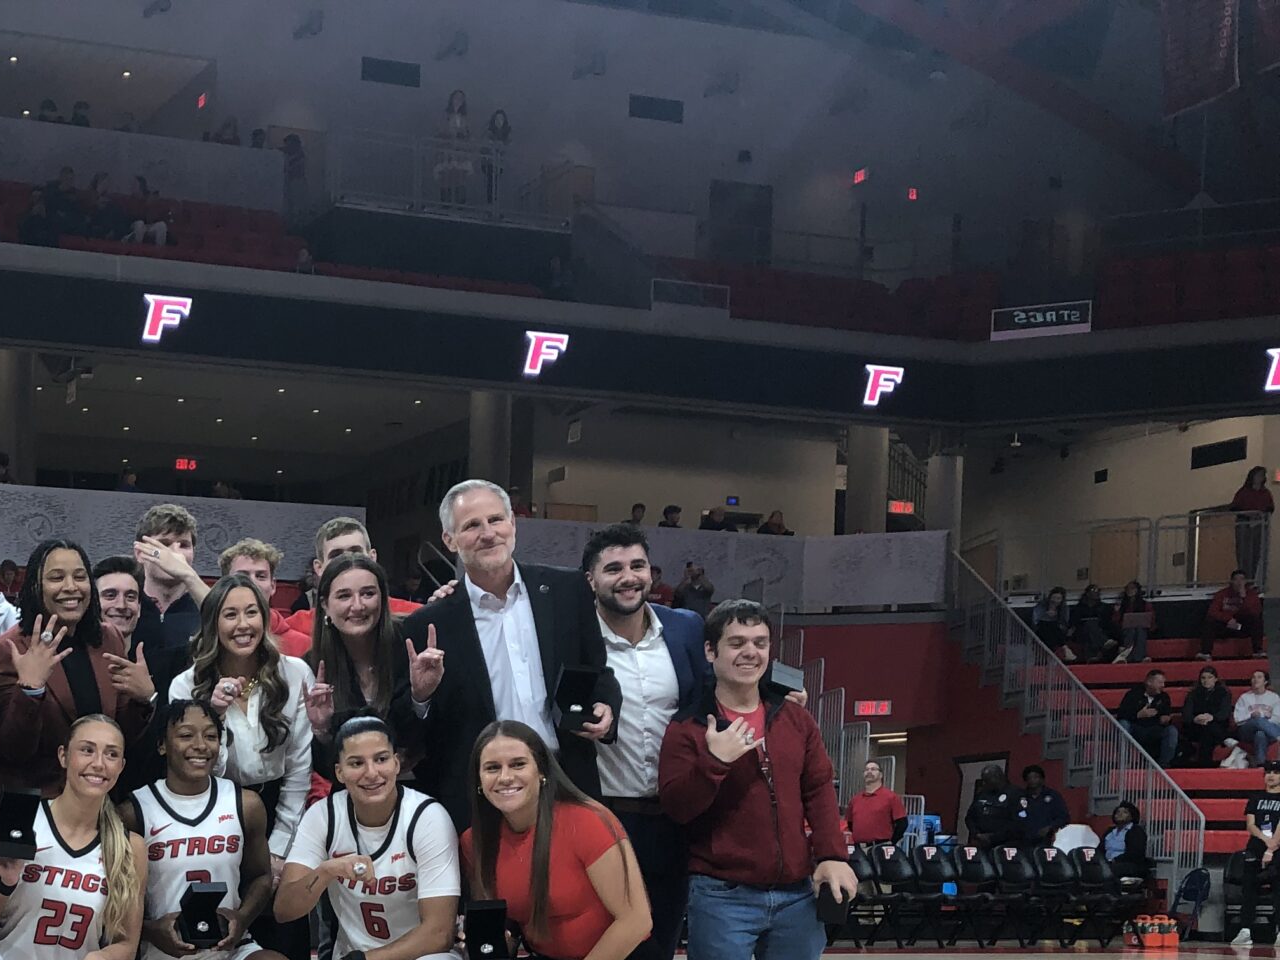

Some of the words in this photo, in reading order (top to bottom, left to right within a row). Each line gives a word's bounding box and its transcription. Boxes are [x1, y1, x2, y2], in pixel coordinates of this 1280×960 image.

[142, 293, 192, 343] F
[524, 331, 569, 376] F
[863, 364, 904, 405] F
[147, 834, 241, 861] STAGS
[33, 897, 95, 950] 23
[360, 901, 391, 940] 6
